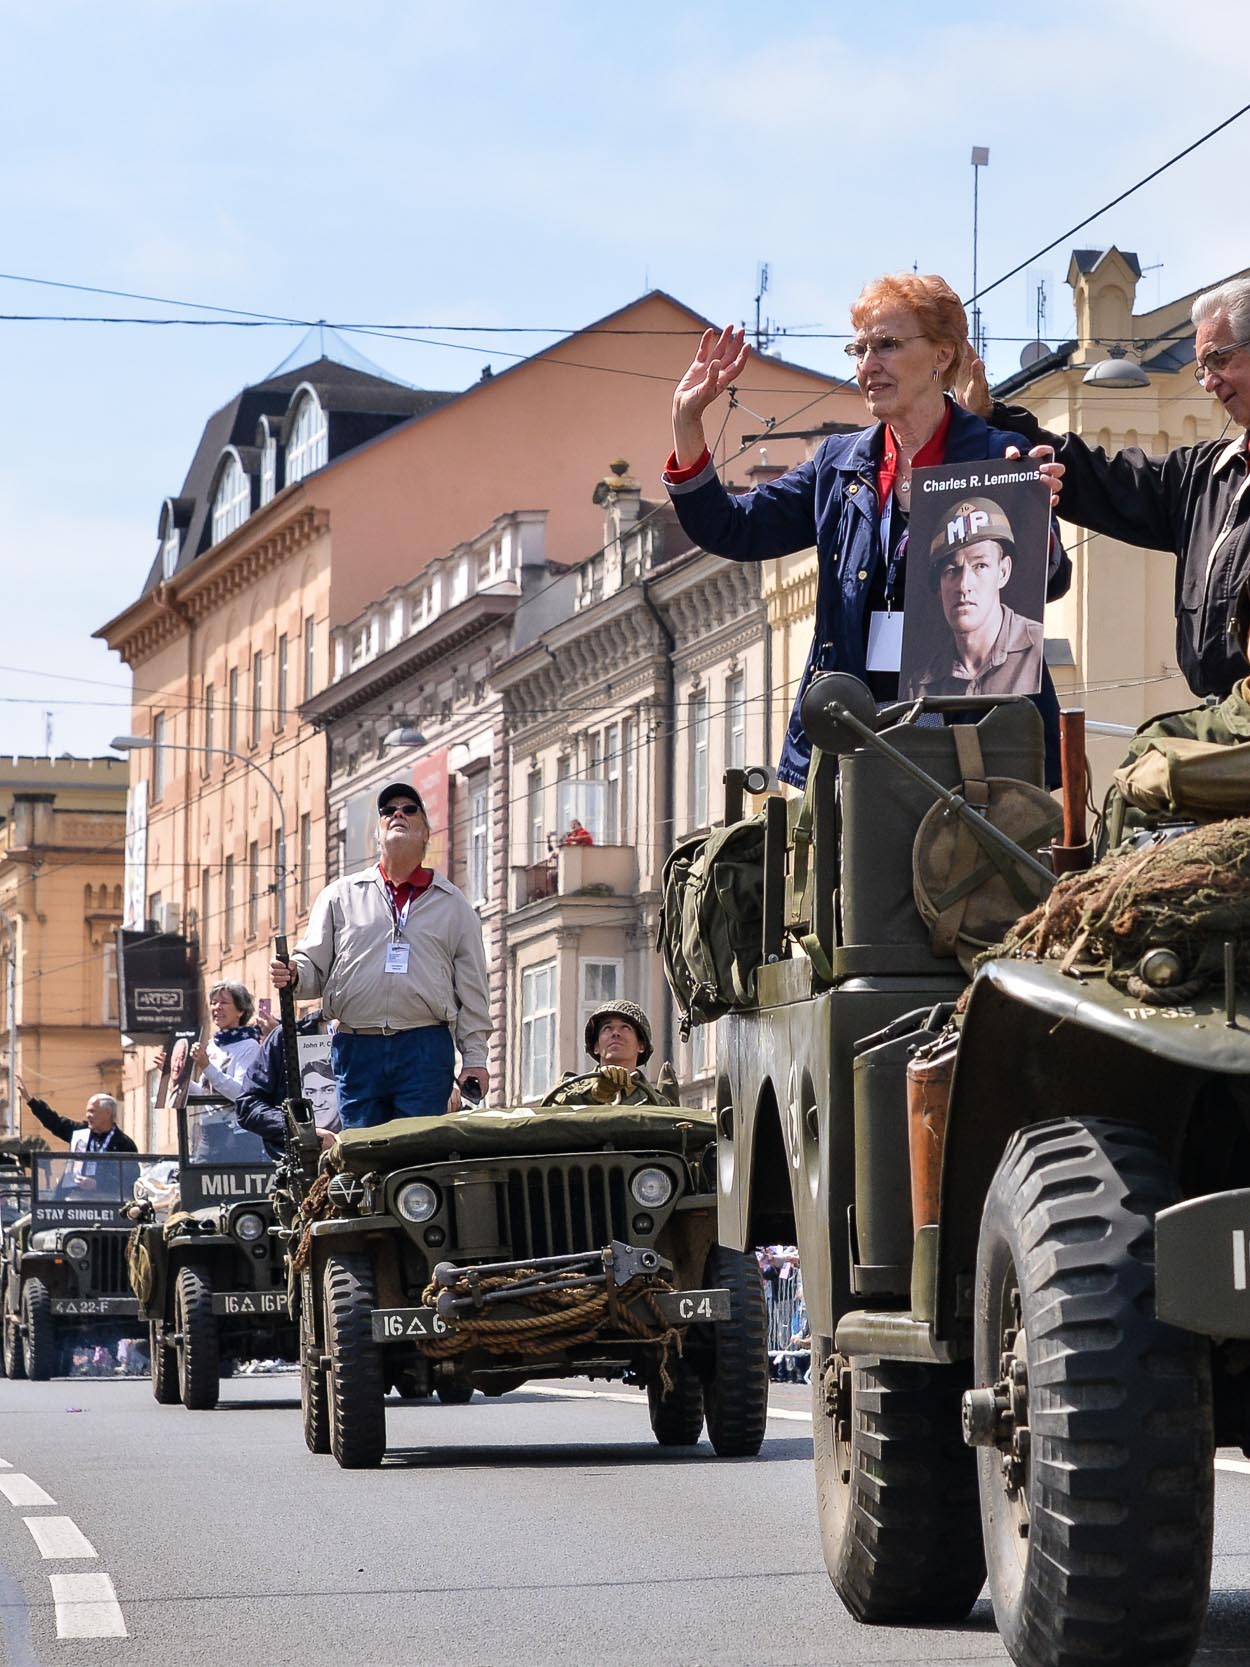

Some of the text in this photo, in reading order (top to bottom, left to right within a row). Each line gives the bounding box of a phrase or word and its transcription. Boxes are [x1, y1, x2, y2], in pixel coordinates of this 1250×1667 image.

[923, 470, 1040, 492] Charles R. Lemmons
[1123, 1007, 1157, 1020] TP
[36, 1209, 114, 1221] STAY SINGLE!
[80, 1301, 109, 1313] 22-F
[225, 1296, 239, 1313] 16
[384, 1315, 403, 1336] 16
